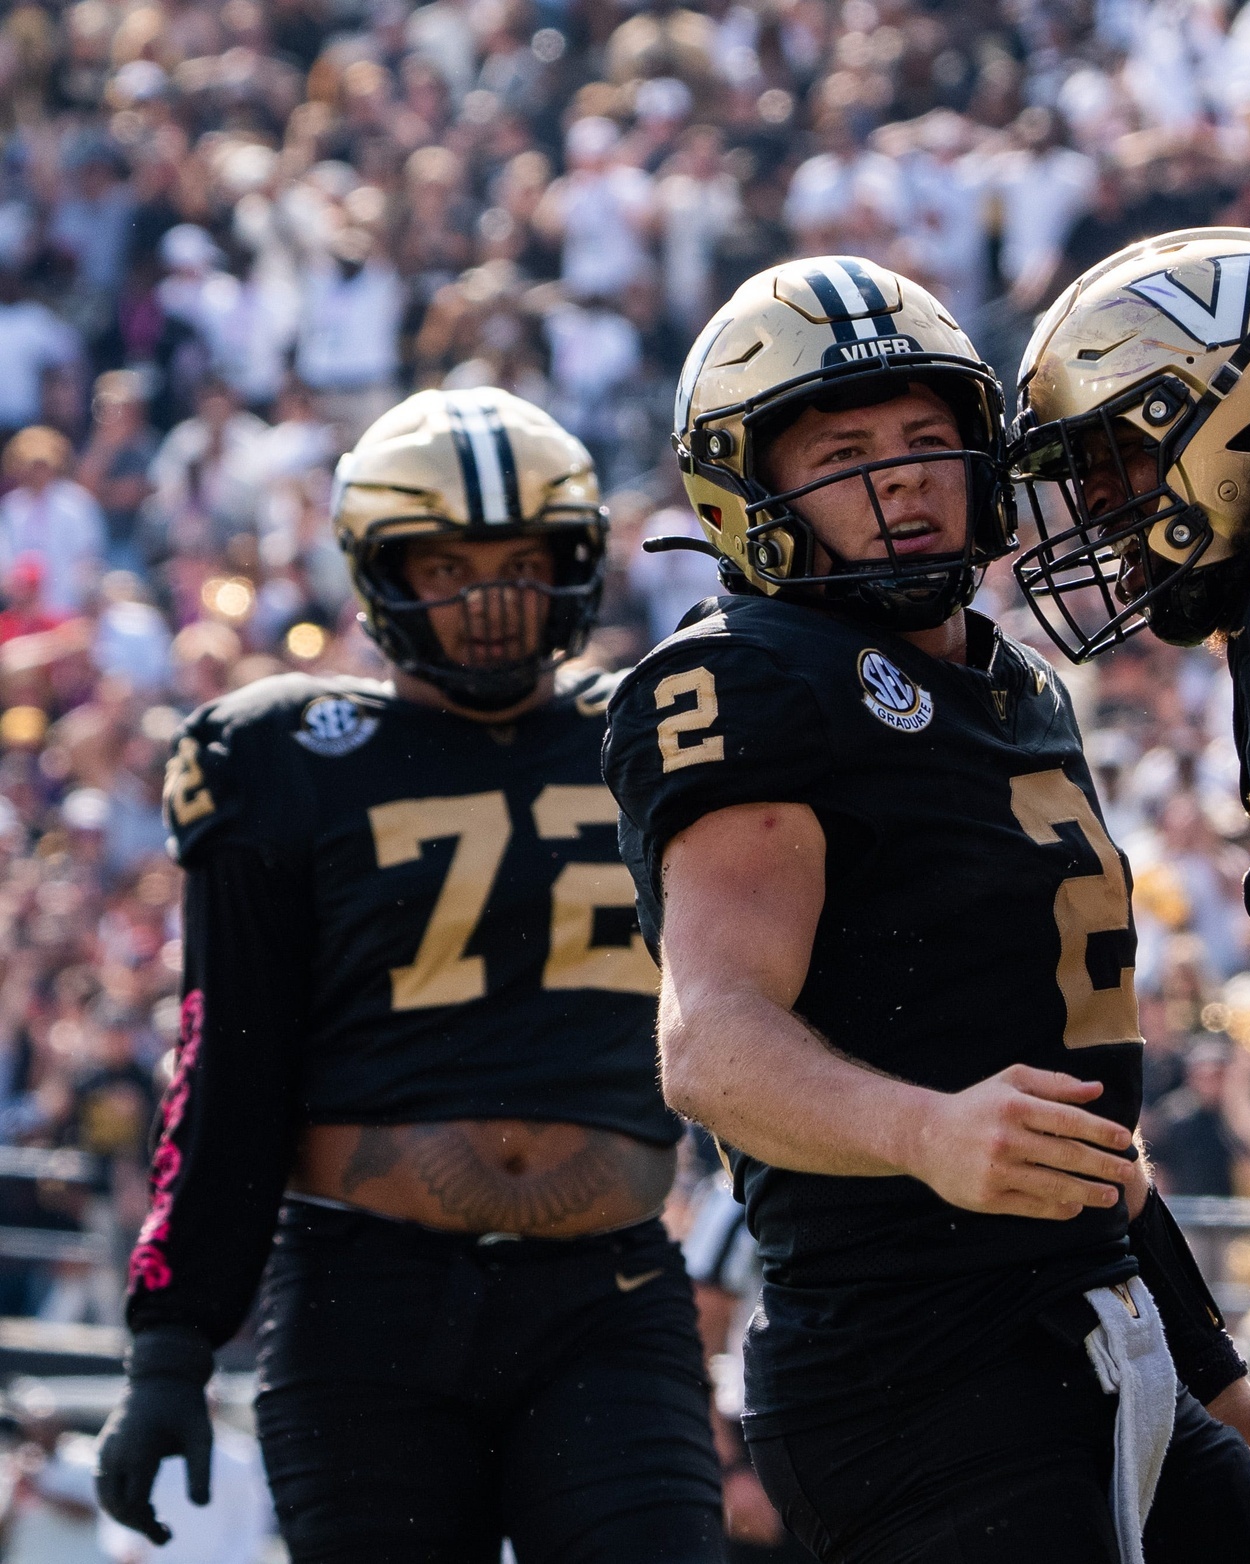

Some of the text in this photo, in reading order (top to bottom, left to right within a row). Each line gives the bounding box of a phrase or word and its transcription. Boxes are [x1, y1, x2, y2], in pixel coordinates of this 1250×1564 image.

[653, 666, 725, 773] 2
[863, 653, 914, 710] SEC
[877, 702, 932, 730] GRADUATE
[367, 785, 661, 1011] 72
[1009, 768, 1146, 1050] 2
